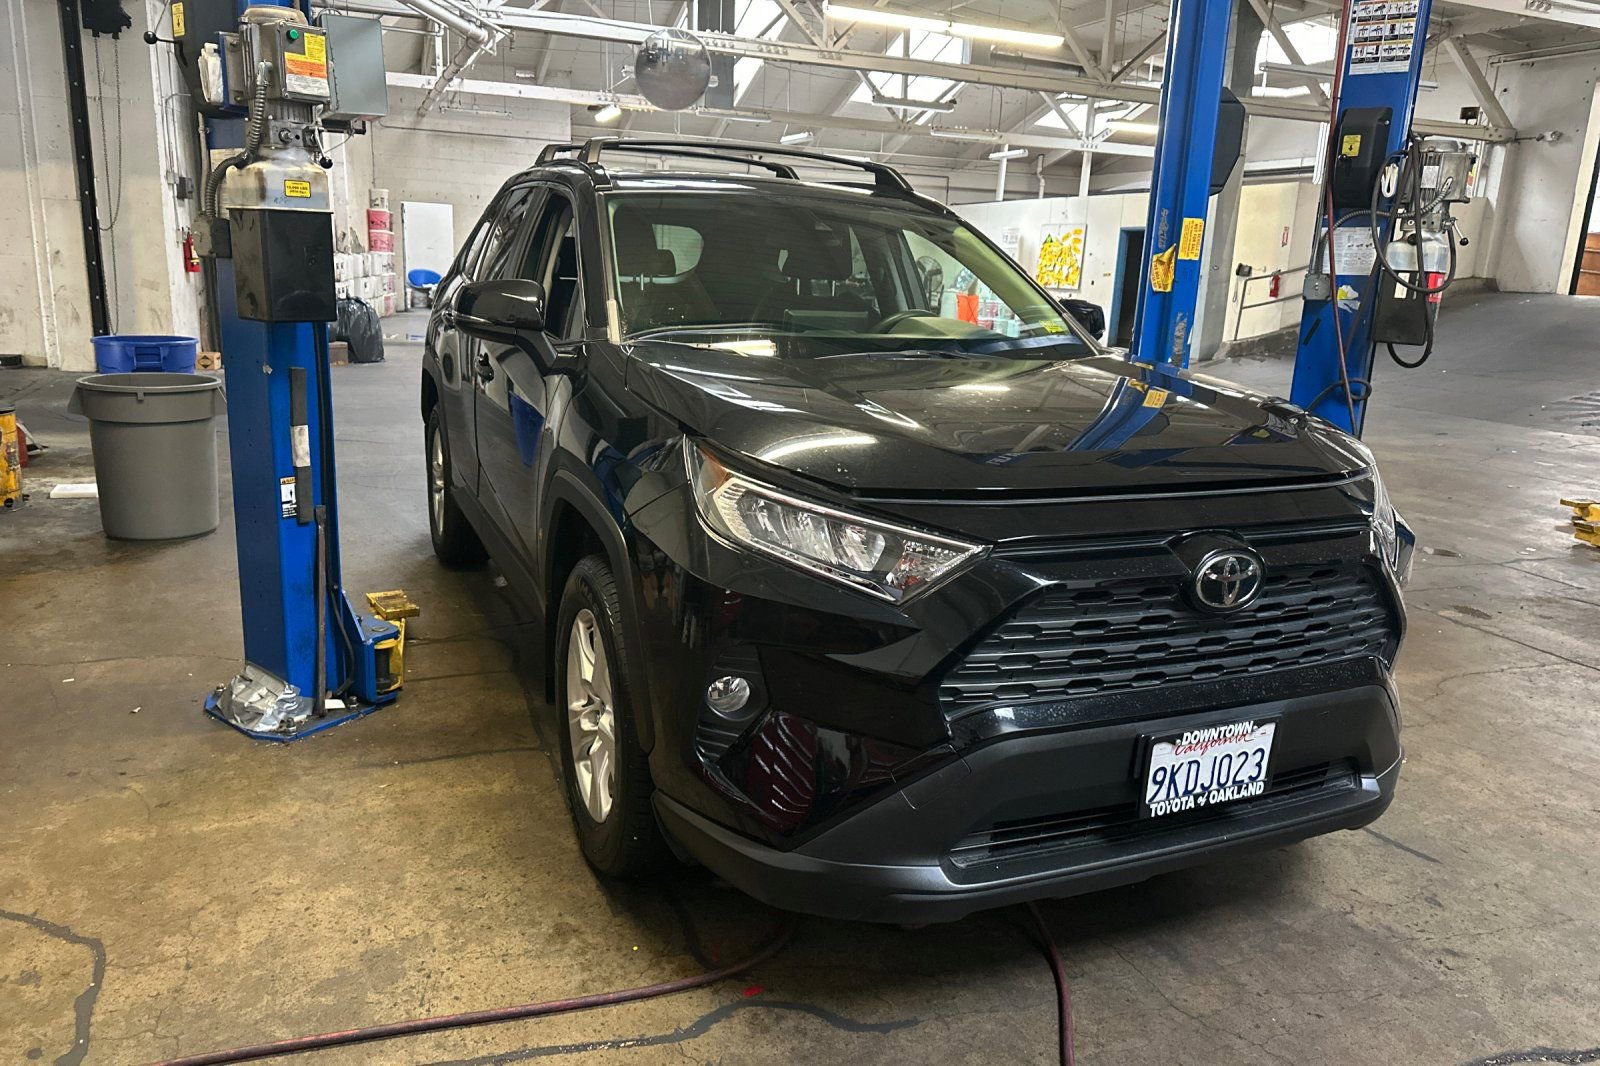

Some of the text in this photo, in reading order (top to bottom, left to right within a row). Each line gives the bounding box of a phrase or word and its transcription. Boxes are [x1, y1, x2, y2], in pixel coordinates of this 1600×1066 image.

[1175, 733, 1254, 756] California
[1182, 721, 1254, 745] DOWNTOWN
[1148, 747, 1265, 803] 9KDJ023
[1150, 781, 1264, 817] TOYOTA of OAKLAND
